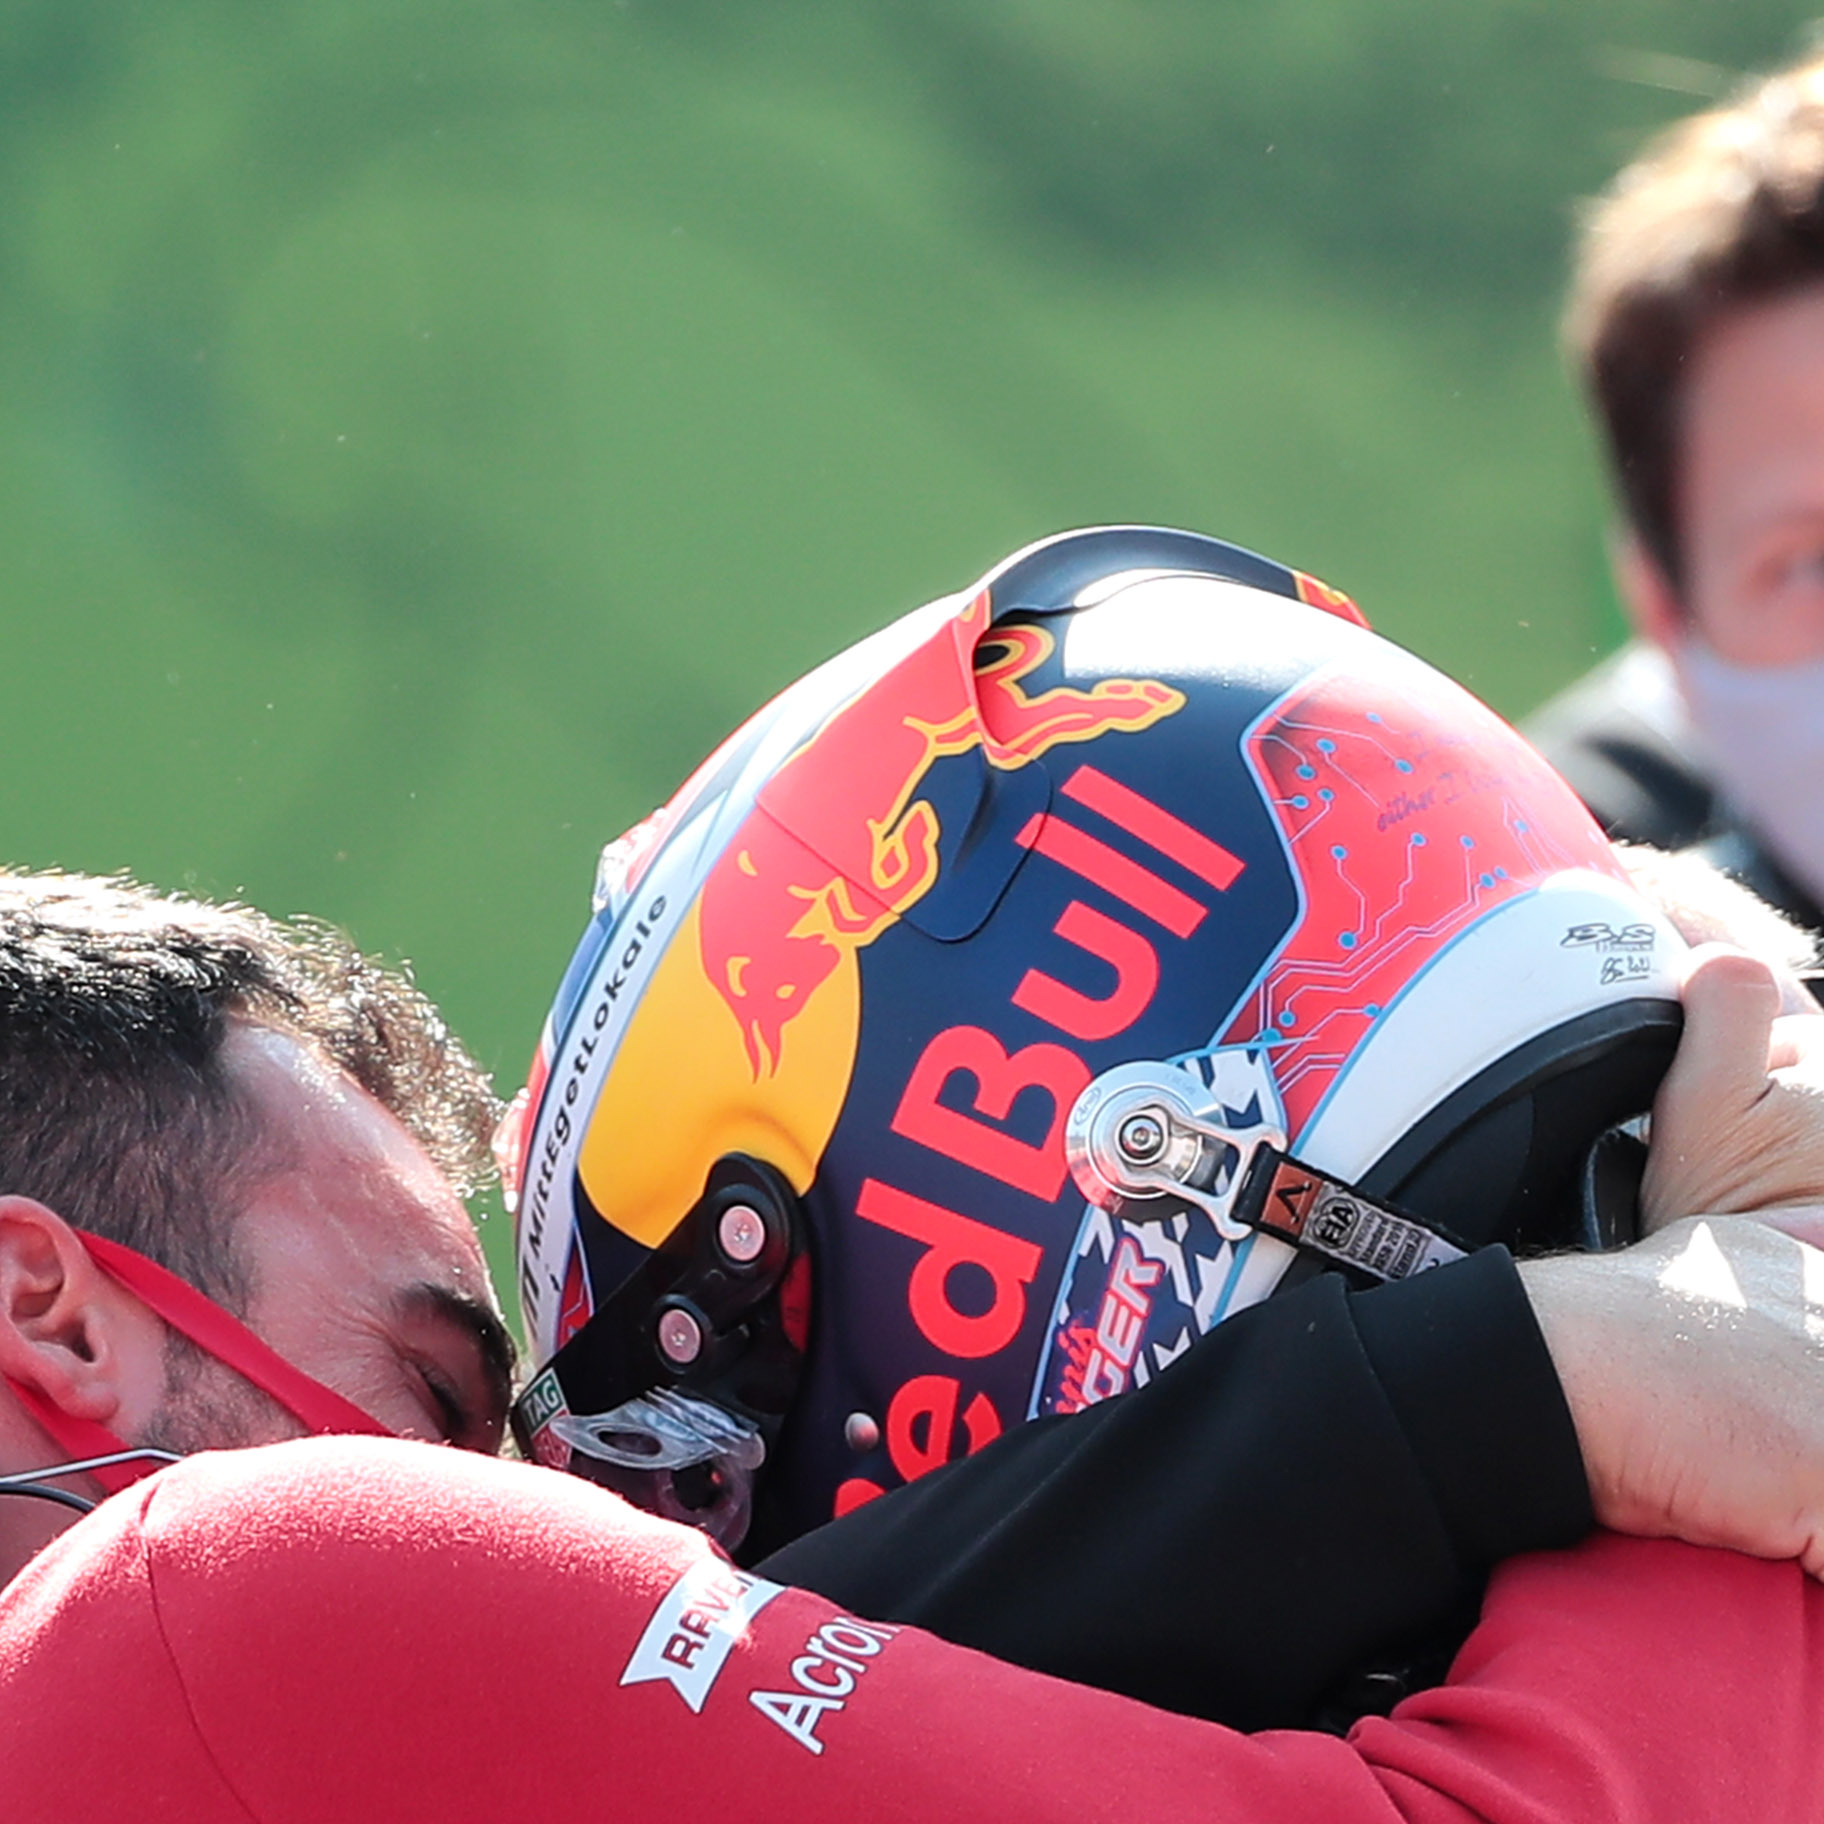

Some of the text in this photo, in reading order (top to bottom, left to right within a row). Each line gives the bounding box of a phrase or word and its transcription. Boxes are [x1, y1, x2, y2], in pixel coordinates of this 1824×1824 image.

[528, 894, 667, 1262] MittEgetLokale
[834, 765, 1247, 1520] ed Bull
[522, 1380, 559, 1427] TAG
[1078, 1238, 1162, 1410] GER
[660, 1570, 754, 1669] RAVE
